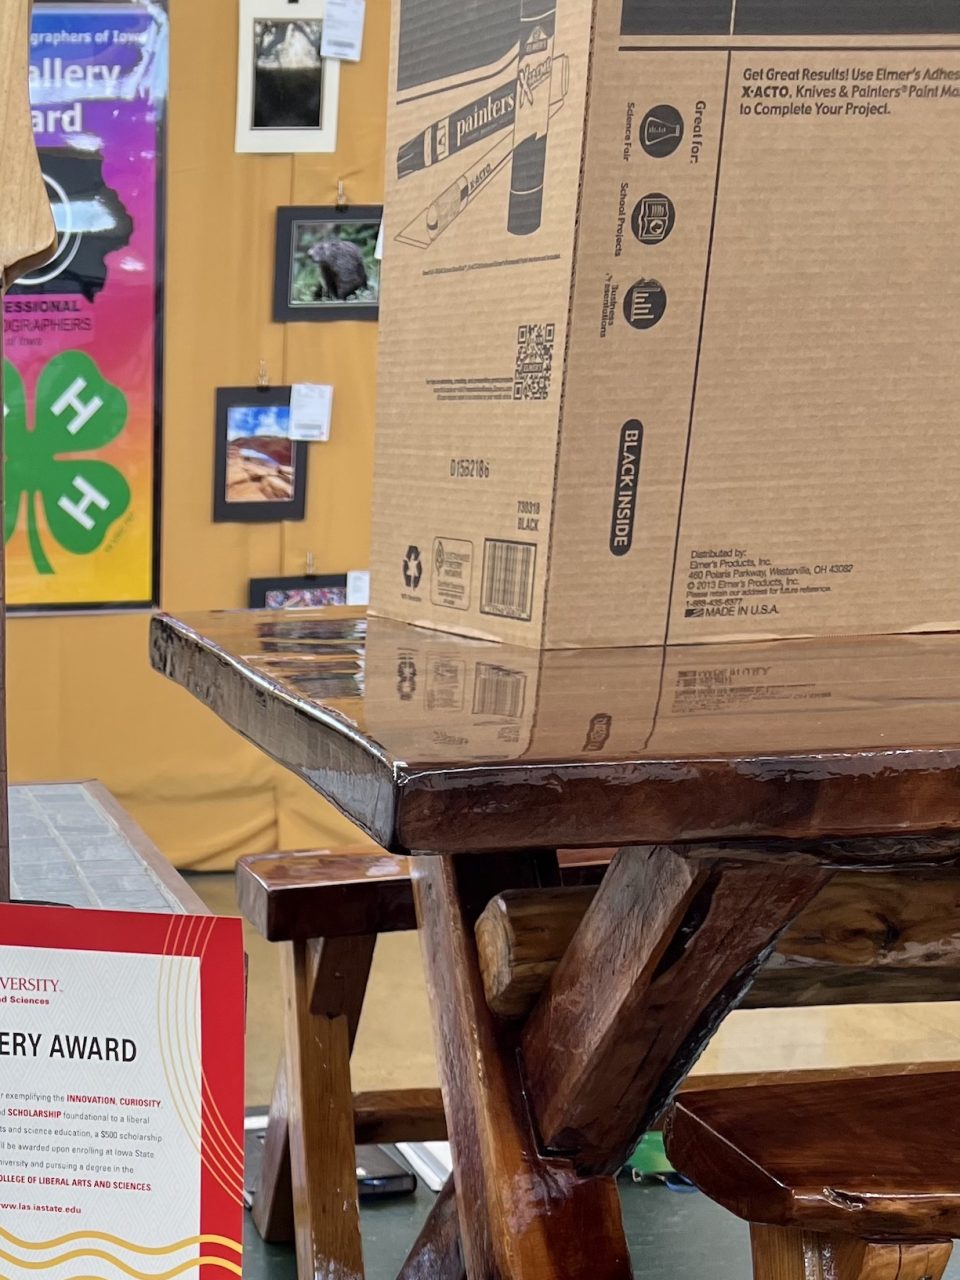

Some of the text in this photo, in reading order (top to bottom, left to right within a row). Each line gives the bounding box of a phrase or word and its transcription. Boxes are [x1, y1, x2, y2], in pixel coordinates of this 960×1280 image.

[31, 30, 92, 47] graphers
[95, 30, 109, 44] of
[29, 57, 121, 95] allery
[743, 68, 764, 81] Get
[766, 68, 800, 81] Great
[802, 68, 849, 81] Results!
[851, 68, 873, 81] Use
[875, 67, 921, 81] Elmer's
[795, 85, 836, 98] Knives
[838, 86, 848, 98] &
[908, 85, 940, 98] Paint
[31, 102, 82, 132] ard
[740, 102, 890, 118] to Complete Your Project.
[456, 93, 515, 146] painters
[623, 102, 636, 162] Science Fair
[689, 100, 707, 164] Great for:
[614, 182, 629, 257] School Projects
[5, 300, 80, 312] ESSIONAL
[3, 318, 92, 331] OGRAPHERS
[613, 430, 639, 547] BLACK INSIDE
[517, 517, 539, 531] BLACK
[691, 549, 747, 559] Distributed by:
[690, 560, 718, 569] Elmer's
[814, 565, 828, 574] OH
[829, 564, 854, 573] 43082
[696, 580, 717, 590] 2013
[718, 580, 746, 589] Elmer's
[705, 606, 735, 617] MADE
[737, 606, 749, 616] IN
[10, 995, 50, 1005] Sciences
[49, 1034, 137, 1063] AWARD
[5, 1092, 51, 1103] exemplifying
[53, 1093, 65, 1101] the
[66, 1094, 118, 1106] INNOVATION,
[7, 1108, 62, 1119] SCHOLARSHIP
[63, 1111, 109, 1122] foundational
[110, 1115, 118, 1123] to
[126, 1116, 150, 1125] liberal
[8, 1126, 22, 1134] and
[23, 1126, 53, 1136] science
[54, 1128, 93, 1139] education,
[100, 1130, 118, 1139] $500
[119, 1132, 163, 1143] scholarship
[7, 1142, 16, 1150] be
[18, 1143, 50, 1152] awarded
[51, 1146, 70, 1155] upon
[71, 1146, 104, 1157] enrolling
[114, 1149, 133, 1157] Iowa
[134, 1150, 155, 1159] State
[30, 1160, 44, 1169] and
[45, 1162, 78, 1172] pursuing
[85, 1163, 112, 1174] degree
[113, 1164, 121, 1173] in
[122, 1165, 134, 1174] the
[27, 1176, 36, 1185] OF
[40, 1177, 70, 1187] LIBERAL
[72, 1179, 92, 1188] ARTS
[93, 1180, 111, 1189] AND
[112, 1181, 153, 1192] SCIENCES.
